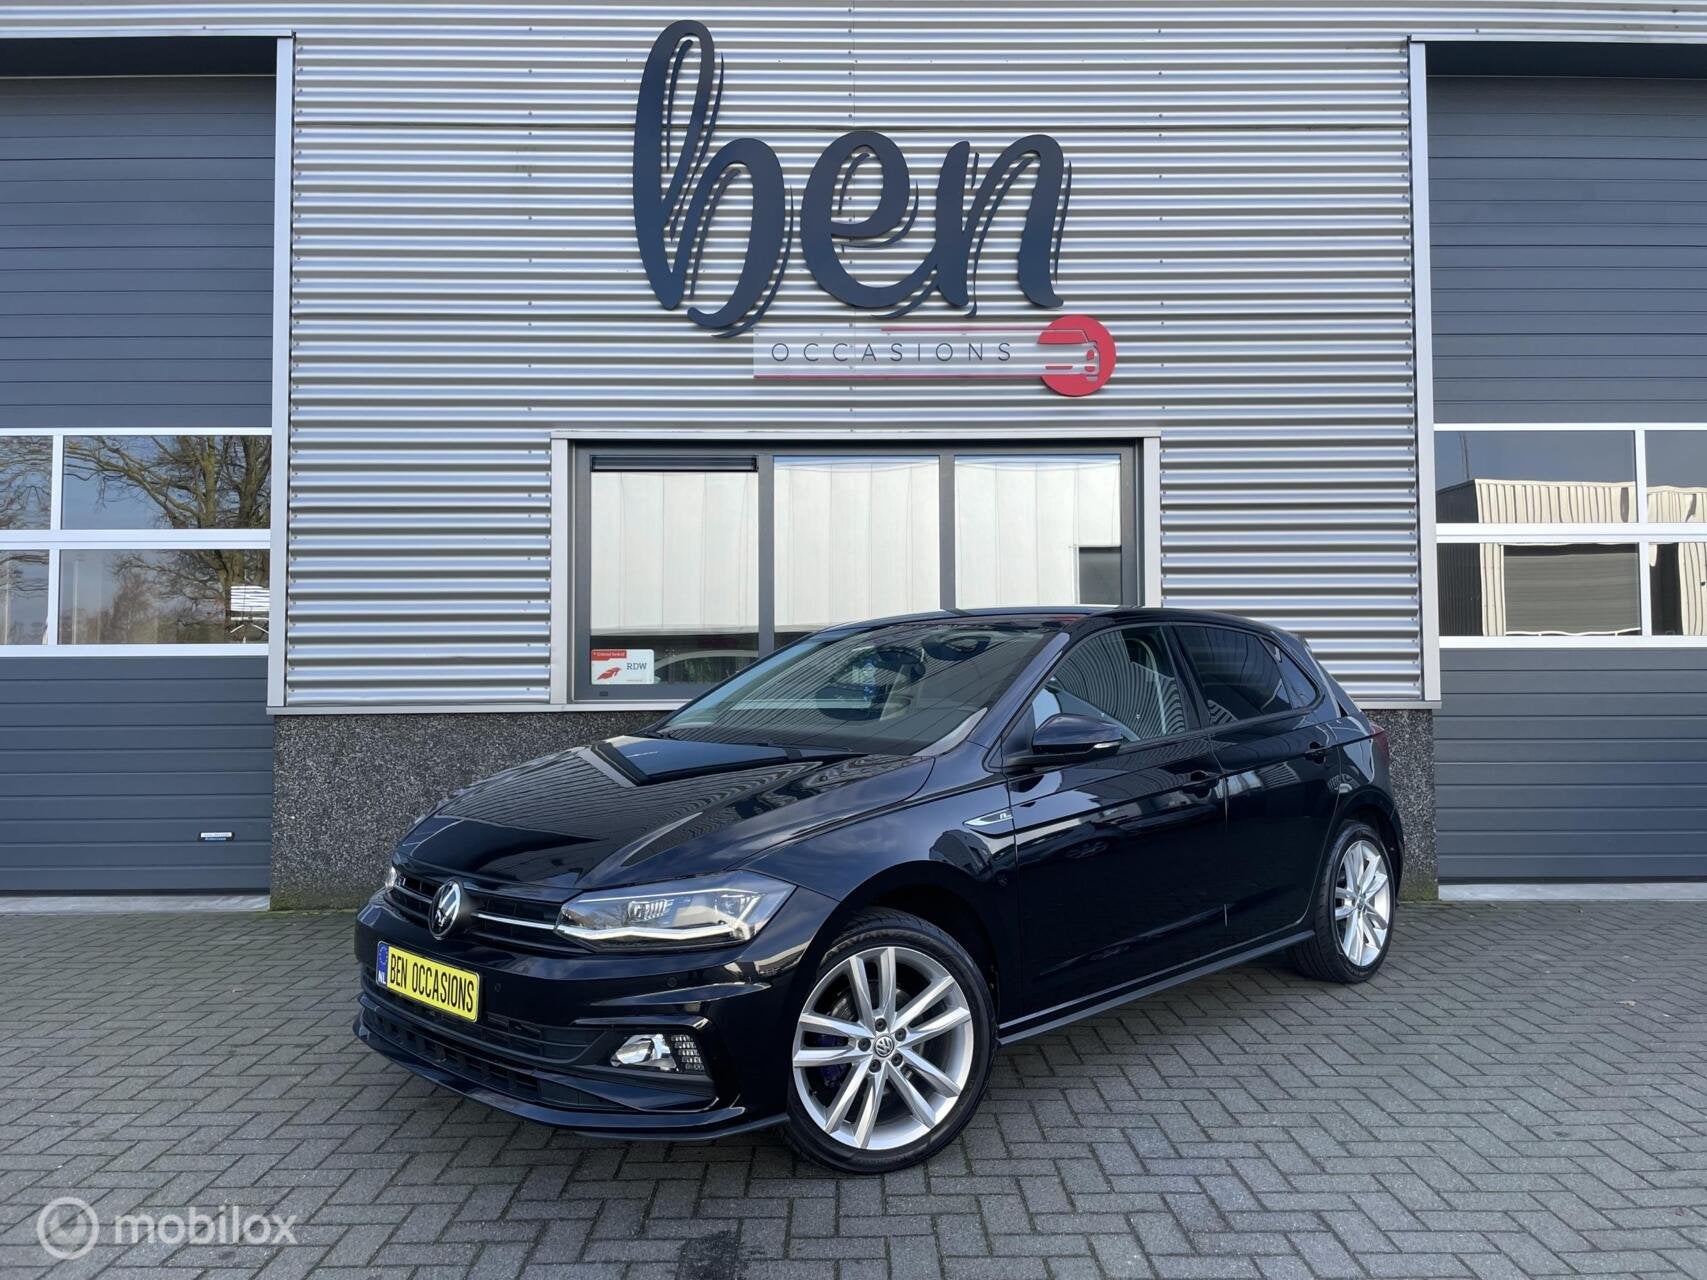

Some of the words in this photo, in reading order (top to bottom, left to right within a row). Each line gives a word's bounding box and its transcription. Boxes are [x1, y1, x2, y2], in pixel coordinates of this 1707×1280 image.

[632, 19, 1072, 338] ben
[771, 342, 1011, 362] OCCASIONS
[626, 662, 647, 670] RDW
[390, 953, 408, 990] BEN
[411, 961, 475, 1013] OCCASIONS
